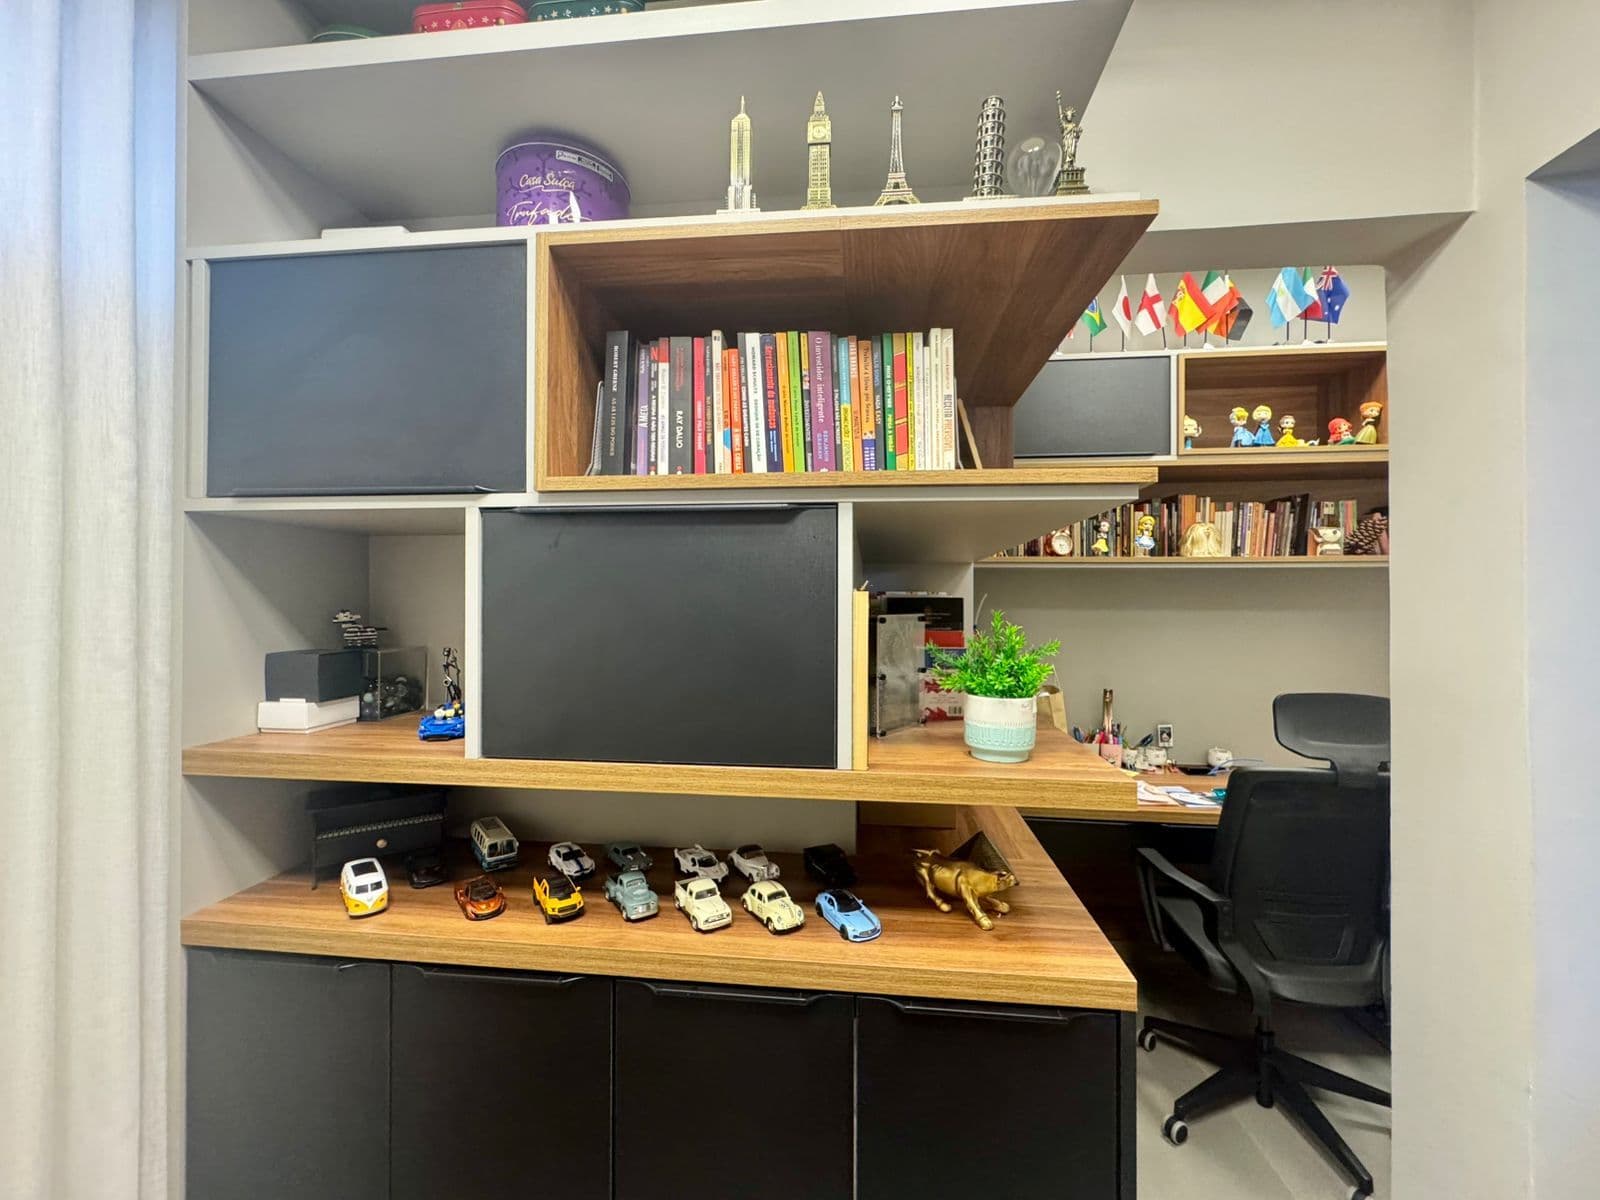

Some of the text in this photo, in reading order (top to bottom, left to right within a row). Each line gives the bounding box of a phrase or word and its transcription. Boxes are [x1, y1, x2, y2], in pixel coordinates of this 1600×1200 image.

[519, 174, 541, 187] Casa
[815, 345, 824, 380] investidor
[815, 384, 826, 423] inteligente
[944, 394, 952, 417] RECEITA
[822, 430, 830, 462] BENJAMIN
